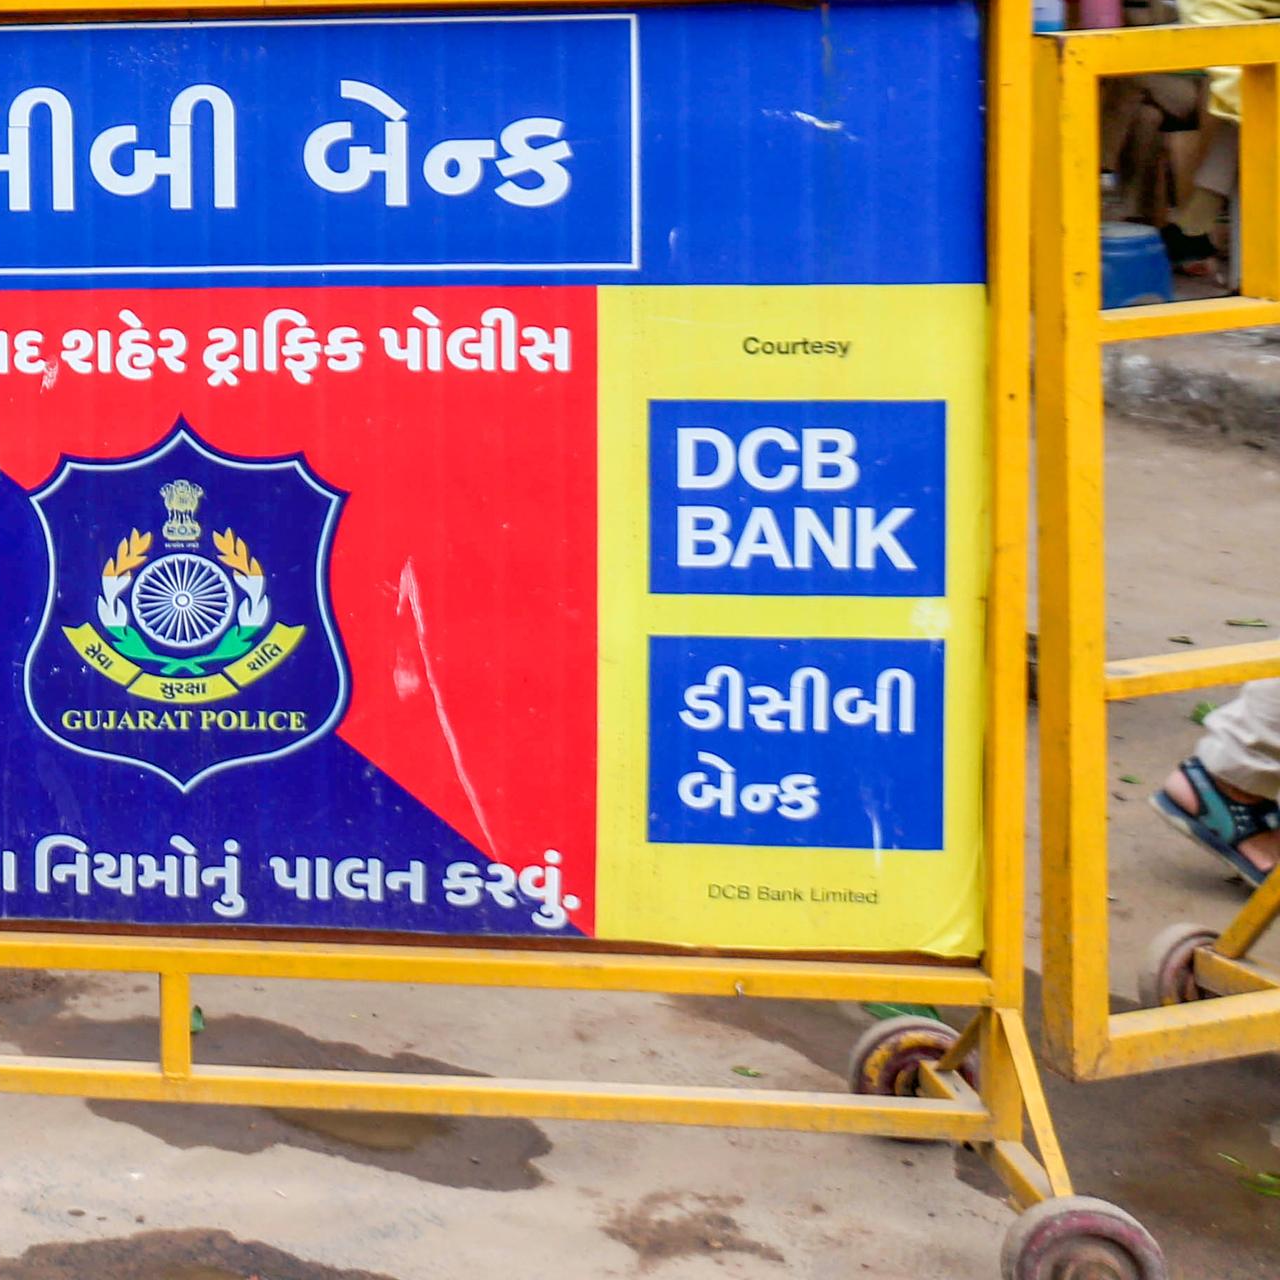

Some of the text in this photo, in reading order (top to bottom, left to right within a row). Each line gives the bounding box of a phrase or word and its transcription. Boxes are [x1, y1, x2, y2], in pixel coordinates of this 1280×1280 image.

[303, 80, 573, 208] બેન્ક
[61, 310, 188, 380] શહેર
[204, 308, 364, 388] ટ્રાફિક
[377, 306, 573, 374] પોલીસ
[742, 336, 852, 358] Courtesy
[676, 426, 860, 492] DCB
[676, 506, 917, 570] BANK
[85, 643, 113, 670] સેવા
[246, 643, 283, 671] શાંતિ
[61, 710, 307, 730] GUJARAT POLICE
[160, 682, 207, 699] સુરક્ષા
[679, 666, 917, 734] ડીસીબી
[678, 752, 821, 820] બેન્ક
[35, 833, 248, 916] નિયમોનું
[269, 854, 426, 904] પાલન
[443, 848, 582, 928] કરવું.
[707, 883, 879, 906] DCB Bank Limited
